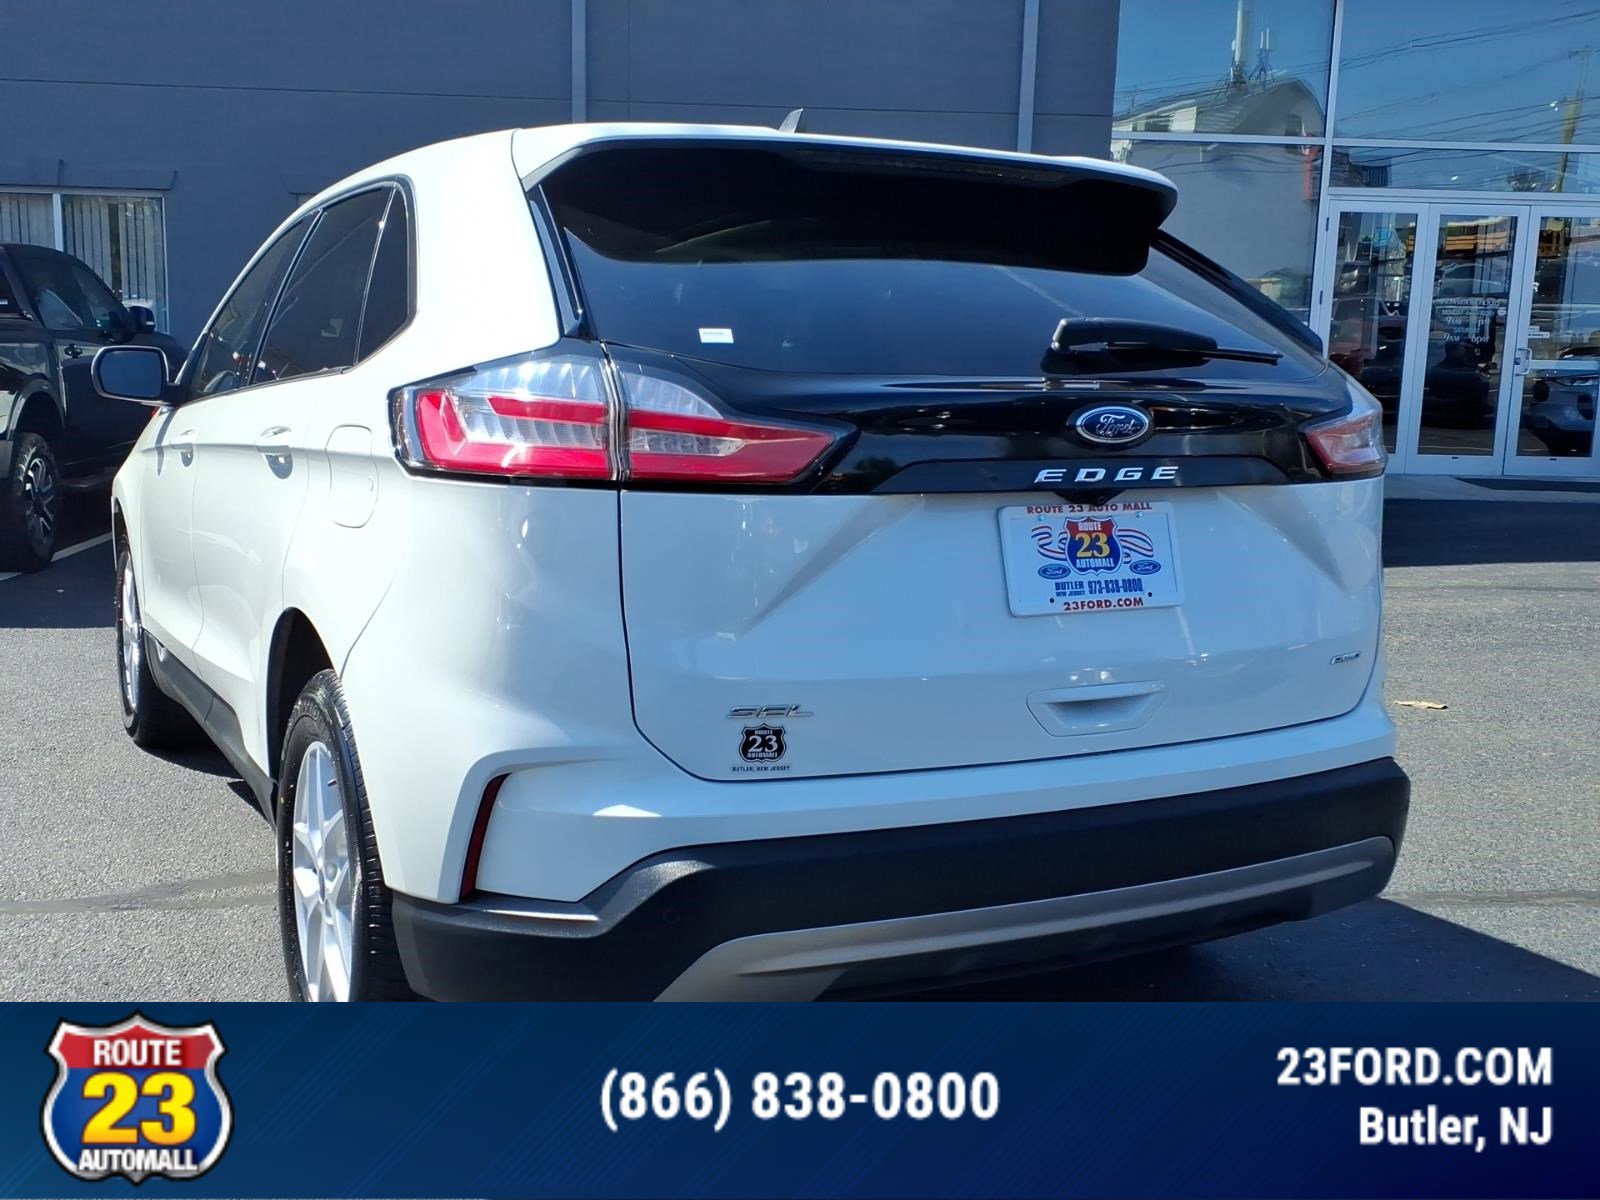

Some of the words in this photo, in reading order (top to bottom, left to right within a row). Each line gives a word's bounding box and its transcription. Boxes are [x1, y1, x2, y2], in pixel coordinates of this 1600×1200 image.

[1034, 466, 1179, 483] EDGE
[1027, 505, 1063, 514] ROUTE
[1069, 504, 1084, 513] 23
[1088, 503, 1118, 512] AUTO
[1123, 502, 1152, 511] MALL
[1078, 521, 1102, 531] ROUTE
[1075, 532, 1110, 558] 23
[1076, 558, 1115, 568] AUTOMALL
[1055, 581, 1084, 590] BUTLER
[1088, 578, 1143, 595] 973-838-0800
[1063, 597, 1144, 611] 23FORD.COM
[748, 735, 778, 752] 23
